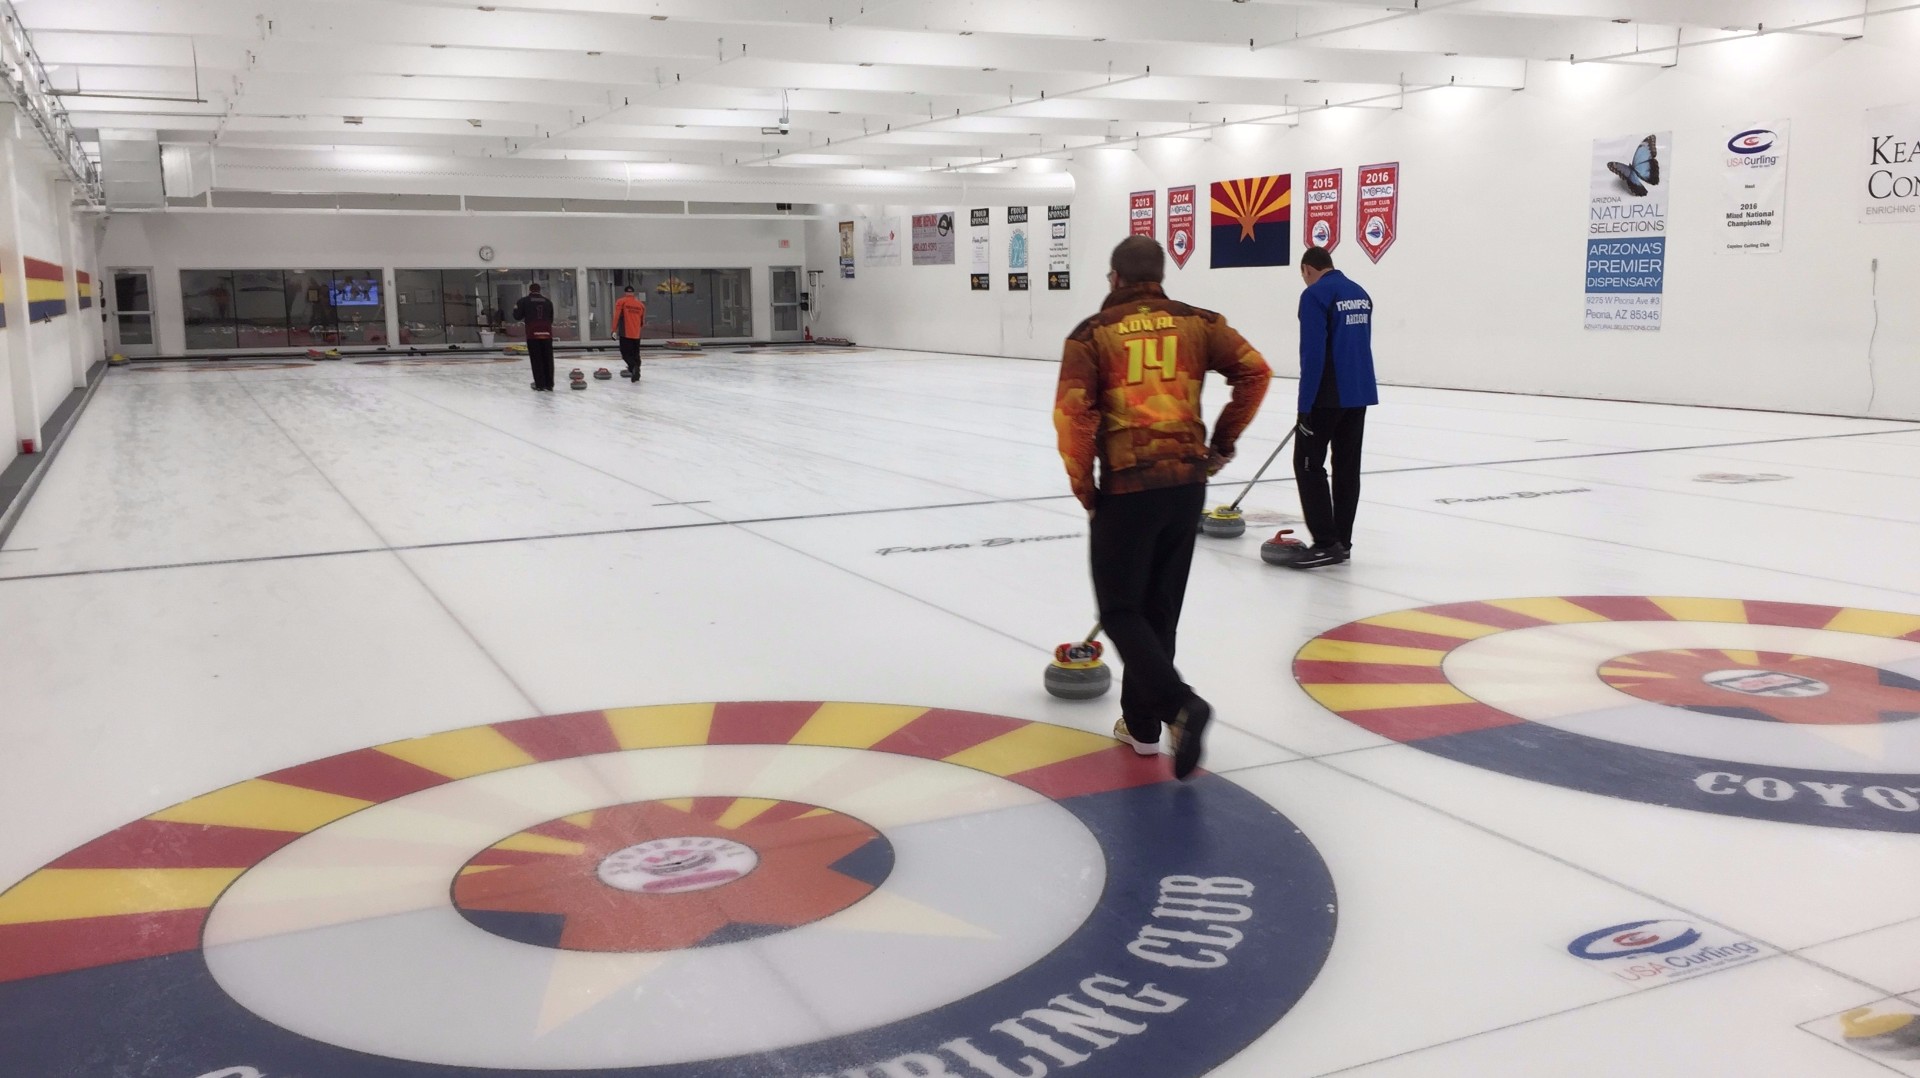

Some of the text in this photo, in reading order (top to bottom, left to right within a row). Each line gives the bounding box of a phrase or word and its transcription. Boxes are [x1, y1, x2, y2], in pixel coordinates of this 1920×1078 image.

[1312, 177, 1334, 189] 2015
[1365, 172, 1389, 184] 2016
[1308, 191, 1337, 202] MOPAC
[1362, 186, 1393, 197] MOPAC
[1135, 197, 1150, 208] 2013
[1172, 193, 1189, 203] 2014
[1592, 196, 1622, 204] ARIZONA
[1010, 206, 1025, 214] PROUD
[1591, 203, 1664, 220] NATURAL
[1740, 203, 1758, 211] 2016
[1865, 204, 1916, 215] ENRICHING
[1008, 214, 1027, 223] SPONSOR
[1048, 210, 1069, 219] SPONSOR
[1746, 210, 1775, 218] National
[971, 217, 989, 225] SPONSOR
[1727, 218, 1772, 228] Championship
[1590, 220, 1665, 234] SELECTIONS
[1589, 242, 1662, 255] ARIZONA'S
[1587, 259, 1662, 273] PREMIER
[1587, 277, 1661, 288] DISPENSARY
[1635, 297, 1649, 305] Ave
[1650, 297, 1660, 305] #3
[1615, 309, 1628, 320] AZ
[1630, 309, 1660, 320] 85345
[1118, 316, 1177, 334] KOWAL
[1124, 335, 1178, 384] 14
[1693, 771, 1920, 813] COYO
[1126, 874, 1256, 969] CLUB
